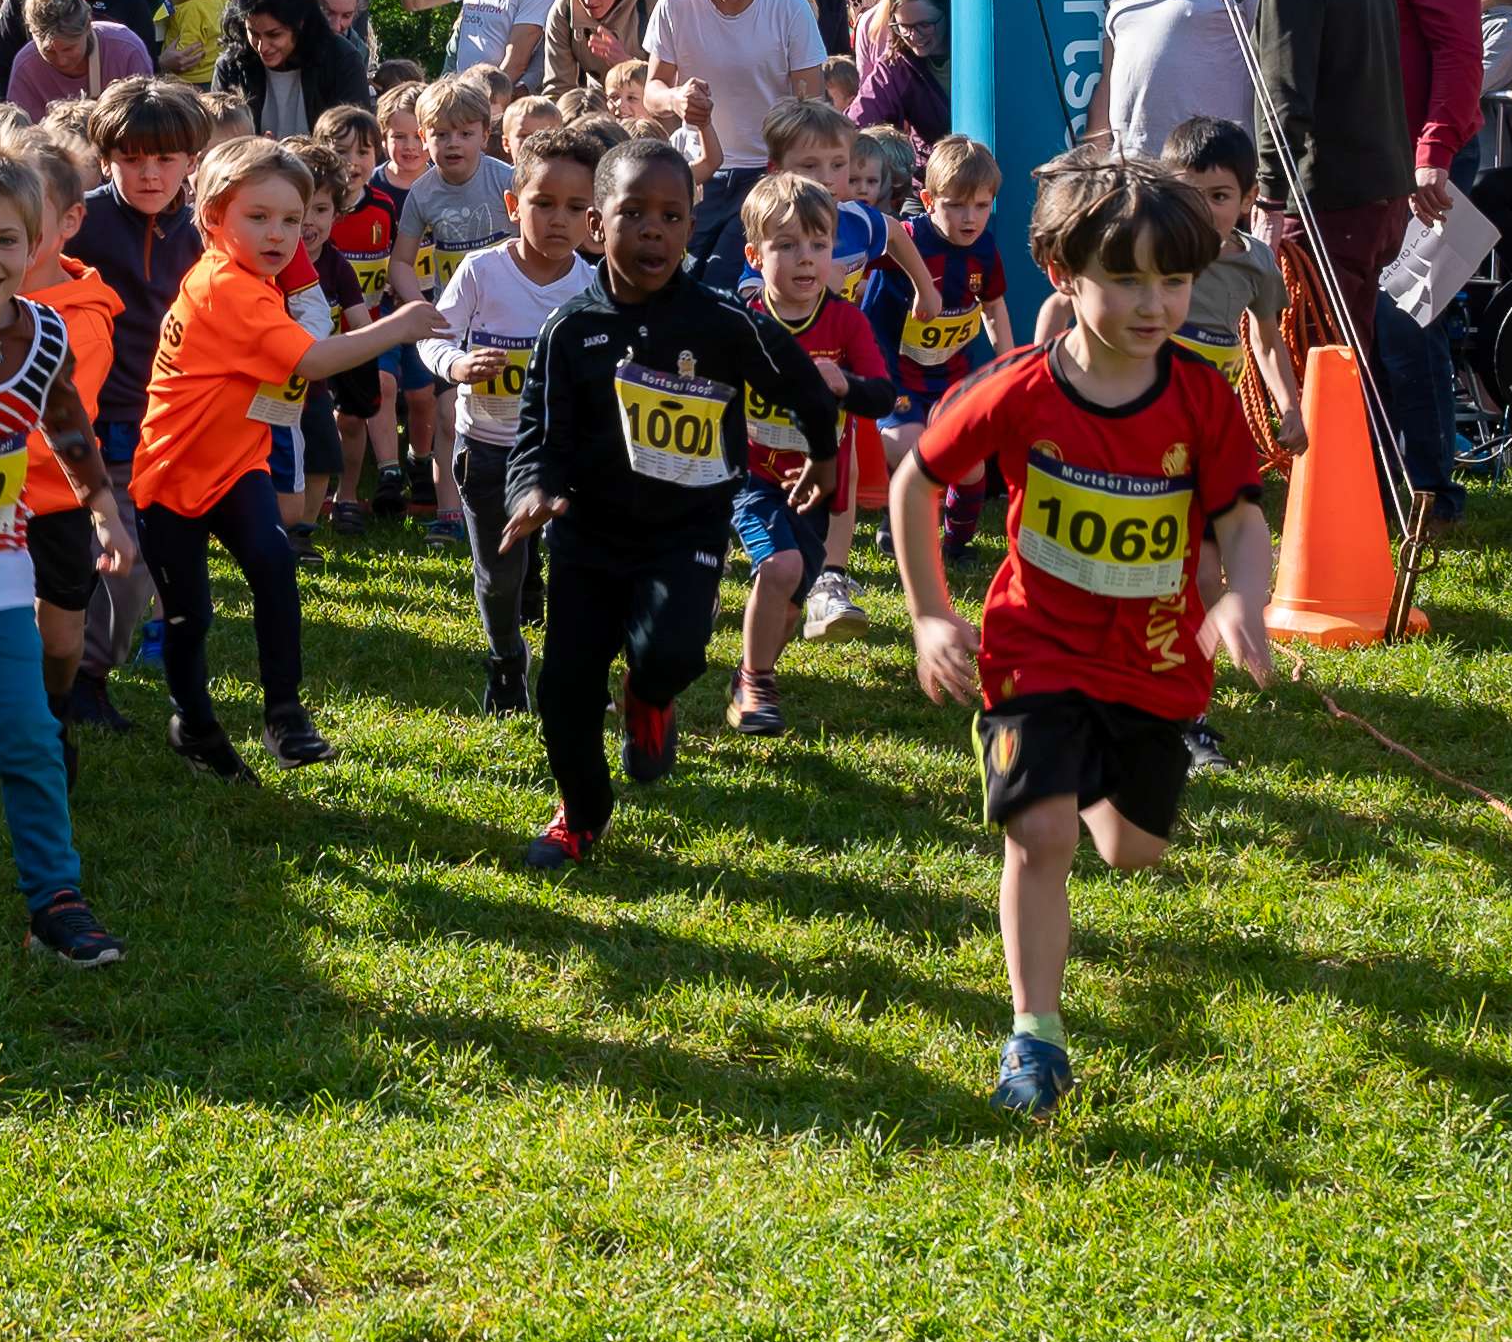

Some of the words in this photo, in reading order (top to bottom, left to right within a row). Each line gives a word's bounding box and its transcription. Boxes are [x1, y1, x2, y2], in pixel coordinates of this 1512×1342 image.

[359, 268, 387, 294] 76
[490, 336, 526, 347] Mortsel
[583, 334, 609, 348] JAKO
[920, 319, 973, 349] 975
[641, 371, 683, 391] Mortsel
[1061, 465, 1121, 490] Mortsel
[1128, 478, 1170, 492] loopt!
[1038, 497, 1179, 563] 1069
